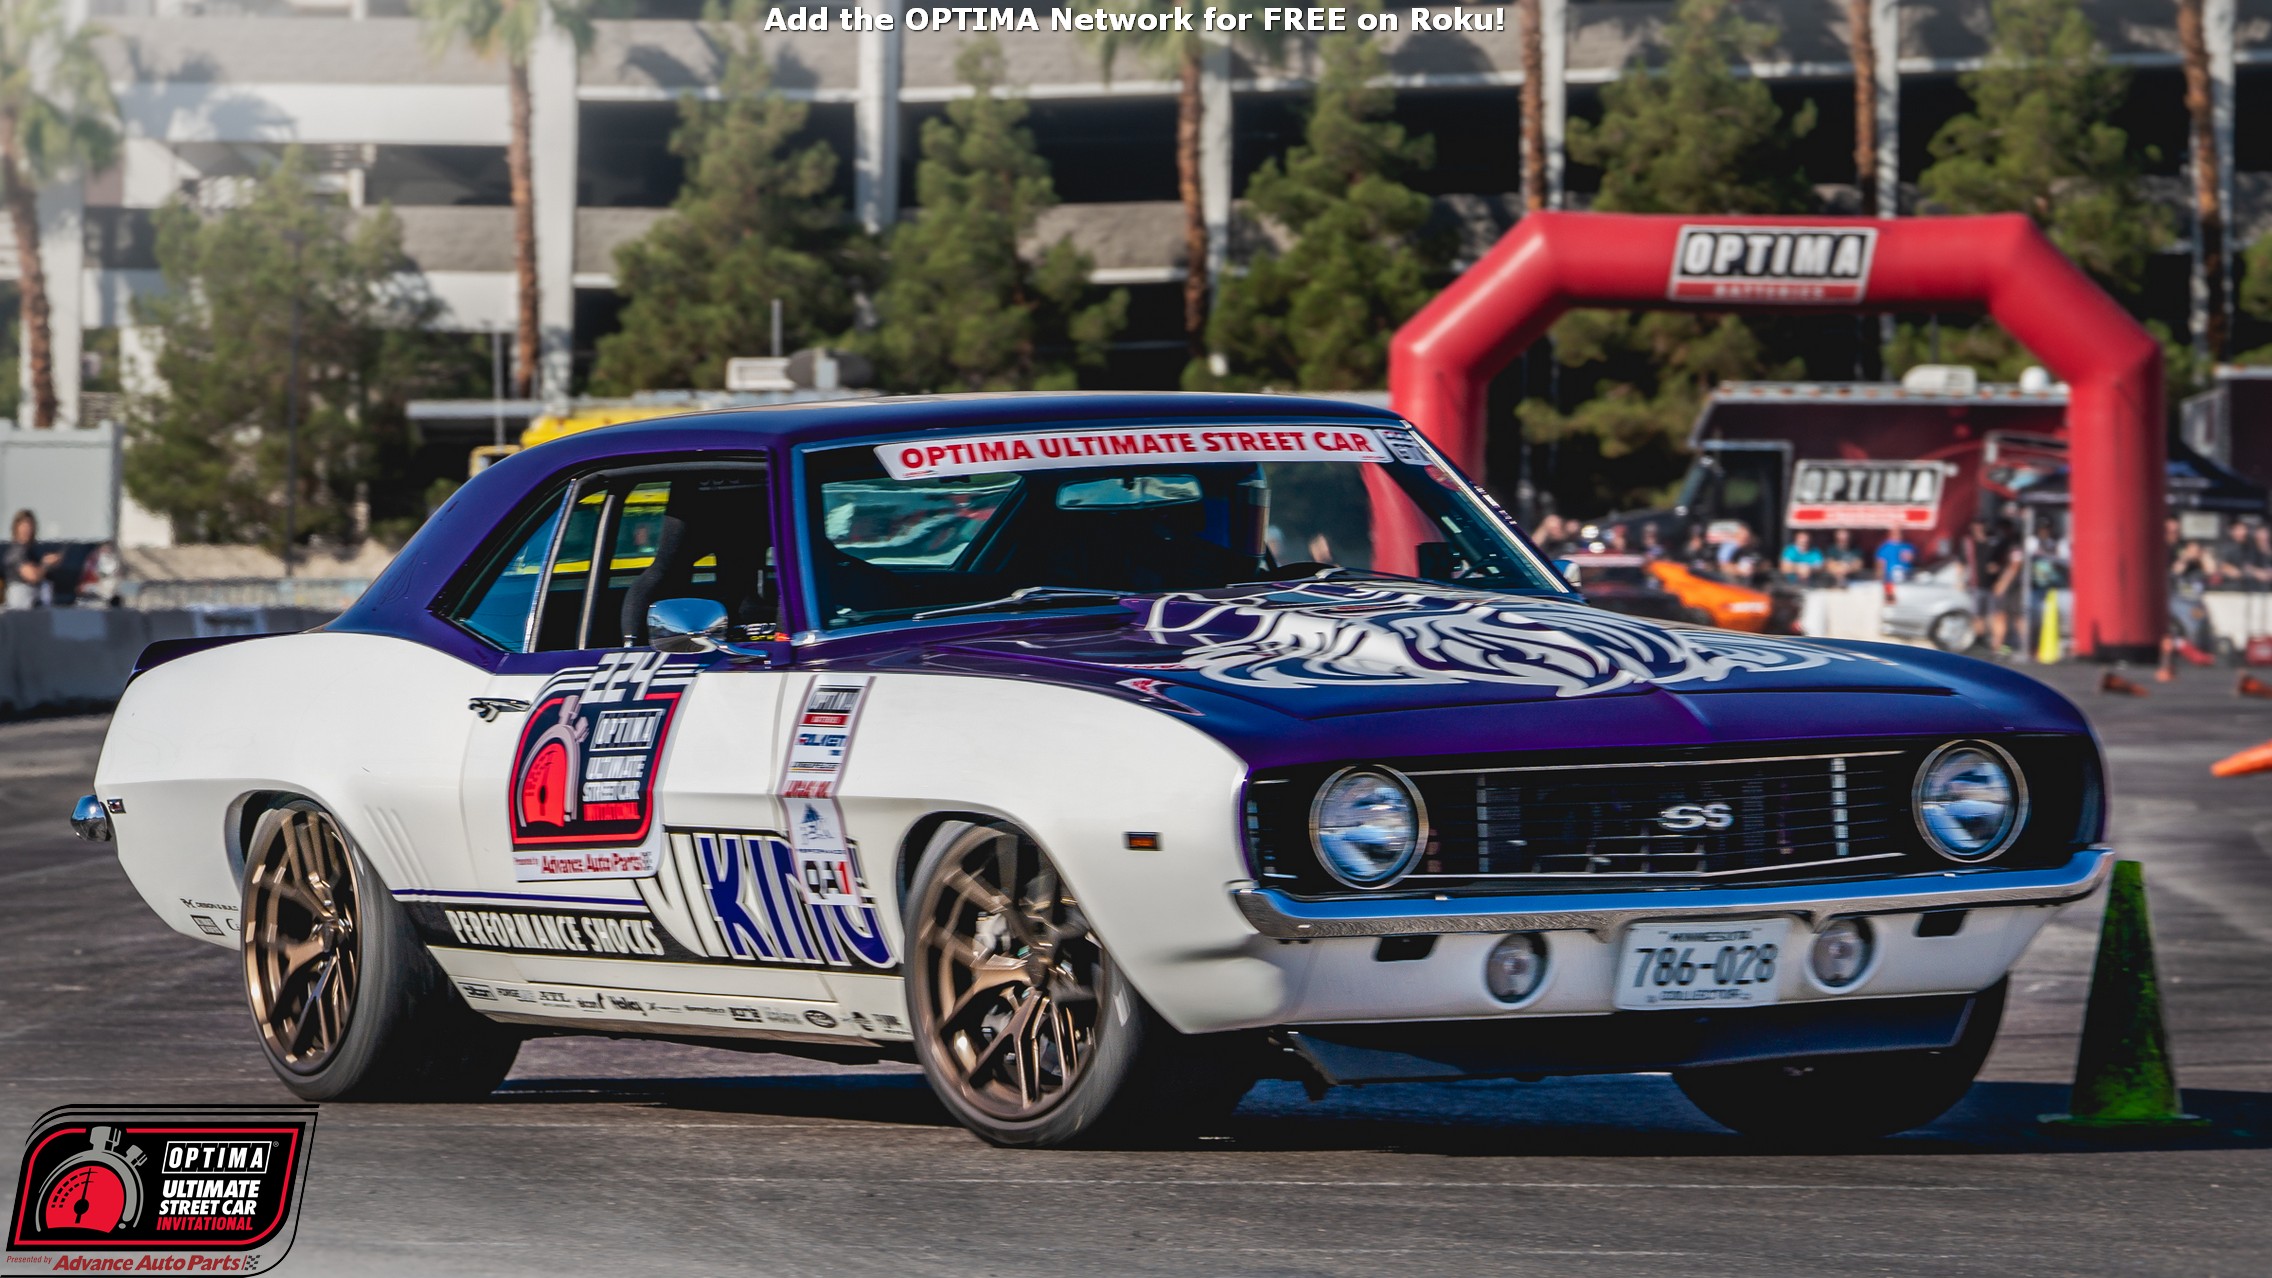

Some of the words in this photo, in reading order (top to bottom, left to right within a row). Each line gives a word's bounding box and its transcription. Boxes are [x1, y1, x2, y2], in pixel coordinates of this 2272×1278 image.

[1683, 233, 1863, 276] OPTIMA
[901, 439, 1036, 469] OPTIMA
[1038, 433, 1198, 459] ULTIMATE
[1201, 431, 1310, 452] STREET
[1312, 431, 1376, 453] CAR
[1797, 468, 1933, 503] OPTIMA
[580, 652, 670, 704] 224
[1658, 803, 1733, 832] SS
[445, 910, 588, 951] PERFORMANCE
[581, 916, 665, 956] SHOCKS
[1633, 943, 1778, 988] 786-028
